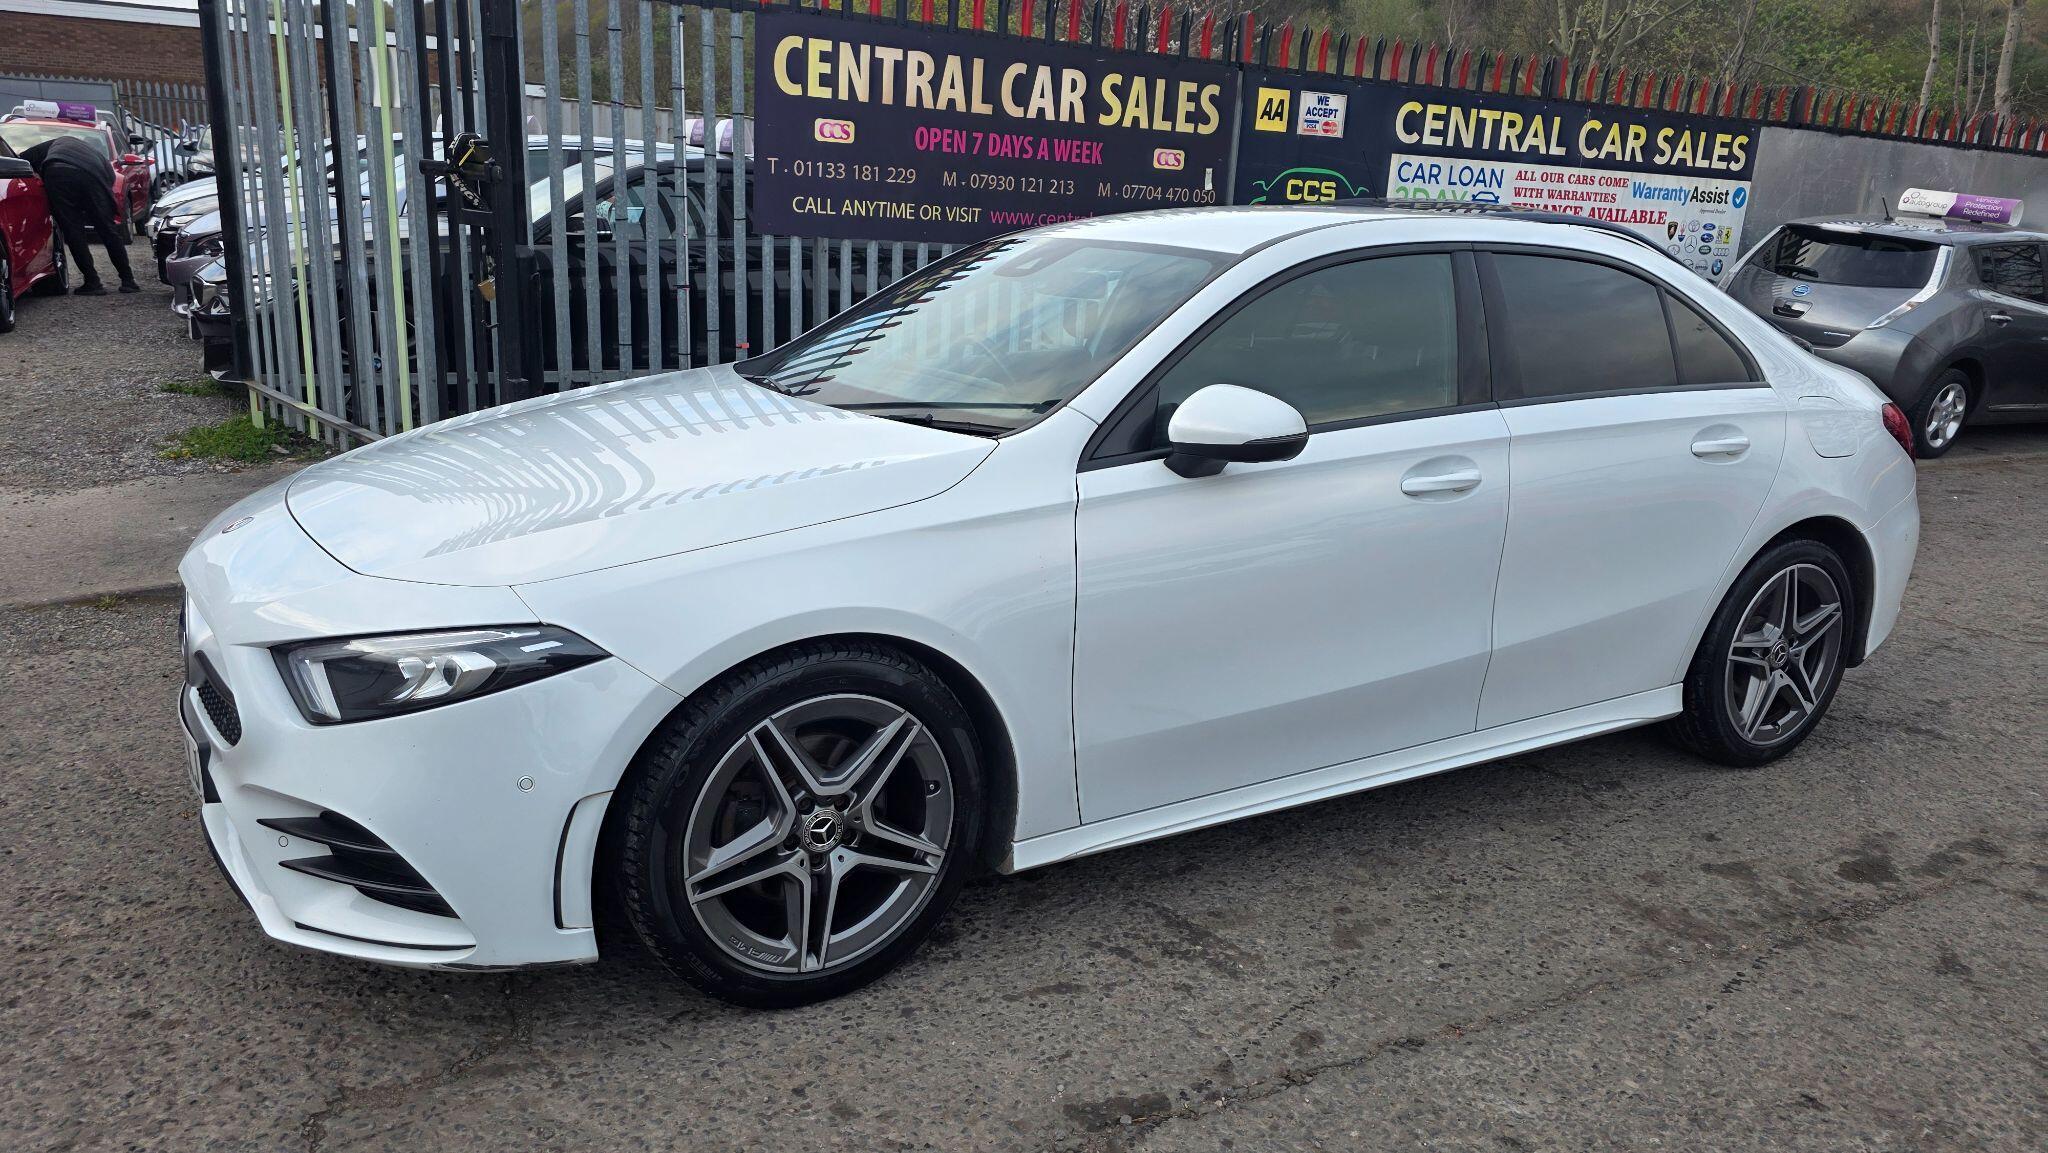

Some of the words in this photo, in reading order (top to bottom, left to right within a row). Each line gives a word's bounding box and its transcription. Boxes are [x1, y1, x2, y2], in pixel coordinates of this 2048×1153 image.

[773, 35, 993, 115] CENTRAL
[1001, 62, 1087, 124] CAR
[1098, 73, 1220, 135] SALES
[1260, 97, 1285, 122] AA
[1317, 95, 1330, 106] WE
[1305, 106, 1339, 119] ACCEPT
[914, 126, 967, 154] OPEN
[972, 132, 984, 155] 7
[988, 133, 1034, 159] DAYS
[1037, 137, 1049, 161] A
[1053, 138, 1104, 165] WEEK
[1395, 101, 1566, 156] CENTRAL
[1578, 119, 1647, 163] CAR
[1652, 127, 1749, 172] SALES
[794, 159, 846, 180] 01133
[853, 164, 879, 182] 181
[885, 167, 916, 184] 229
[1397, 161, 1442, 185] CAR
[1448, 165, 1504, 188] LOAN
[1515, 170, 1537, 182] ALL
[1540, 171, 1564, 184] OUR
[1568, 173, 1595, 186] CARS
[1598, 176, 1630, 188] COME
[970, 173, 1015, 192] 07930
[1020, 177, 1043, 193] 121
[1049, 179, 1074, 195] 213
[1122, 184, 1162, 201] 07704
[1166, 187, 1190, 203] 470
[1193, 188, 1216, 204] 050
[1286, 178, 1337, 202] CCS
[1513, 186, 1544, 199] WITH
[1547, 189, 1617, 204] WARRANTIES
[792, 196, 836, 215] CALL
[841, 199, 915, 220] ANYTIME
[920, 204, 941, 221] OR
[945, 205, 982, 223] VISIT
[1588, 206, 1668, 225] AVAILABLE
[1963, 207, 2000, 219] Redefined
